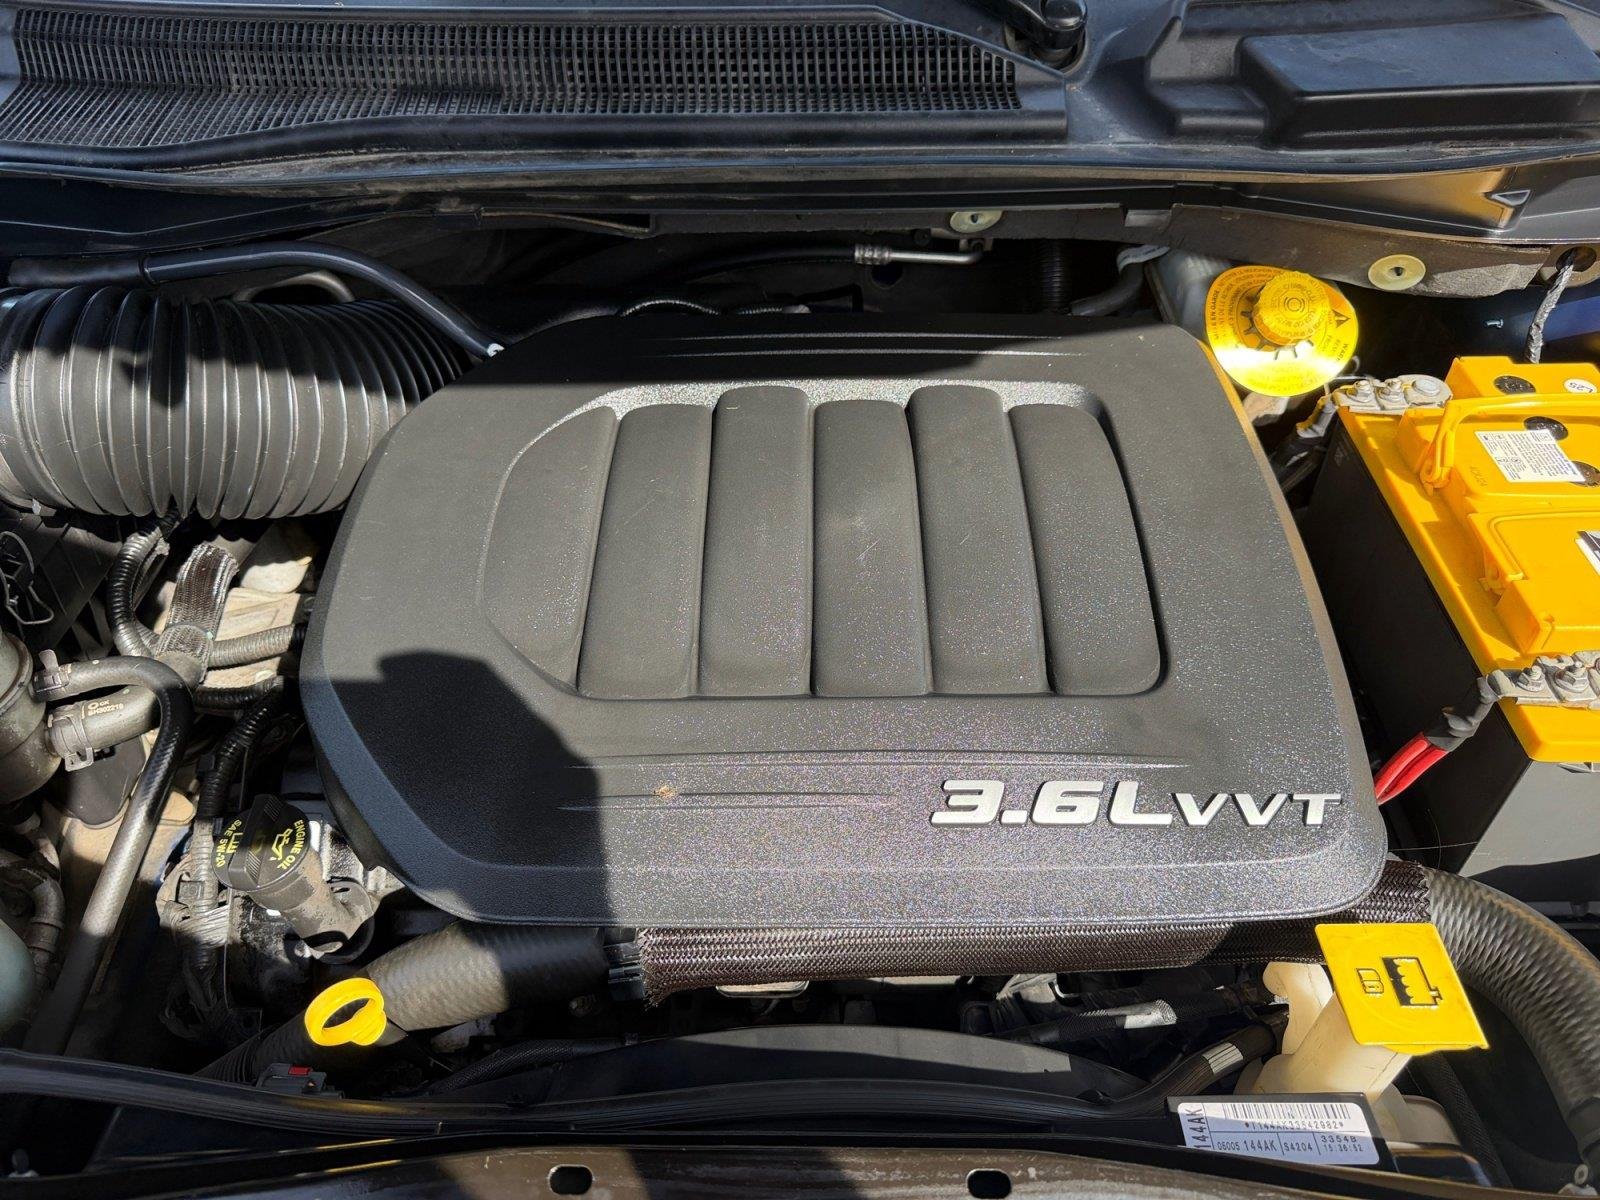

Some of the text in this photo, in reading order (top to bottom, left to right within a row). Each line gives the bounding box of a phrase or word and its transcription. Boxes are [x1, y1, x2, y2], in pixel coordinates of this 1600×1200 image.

[215, 819, 242, 868] SAE 5W-20
[276, 819, 306, 870] ENGINE OIL
[1243, 1138, 1277, 1152] 144AK
